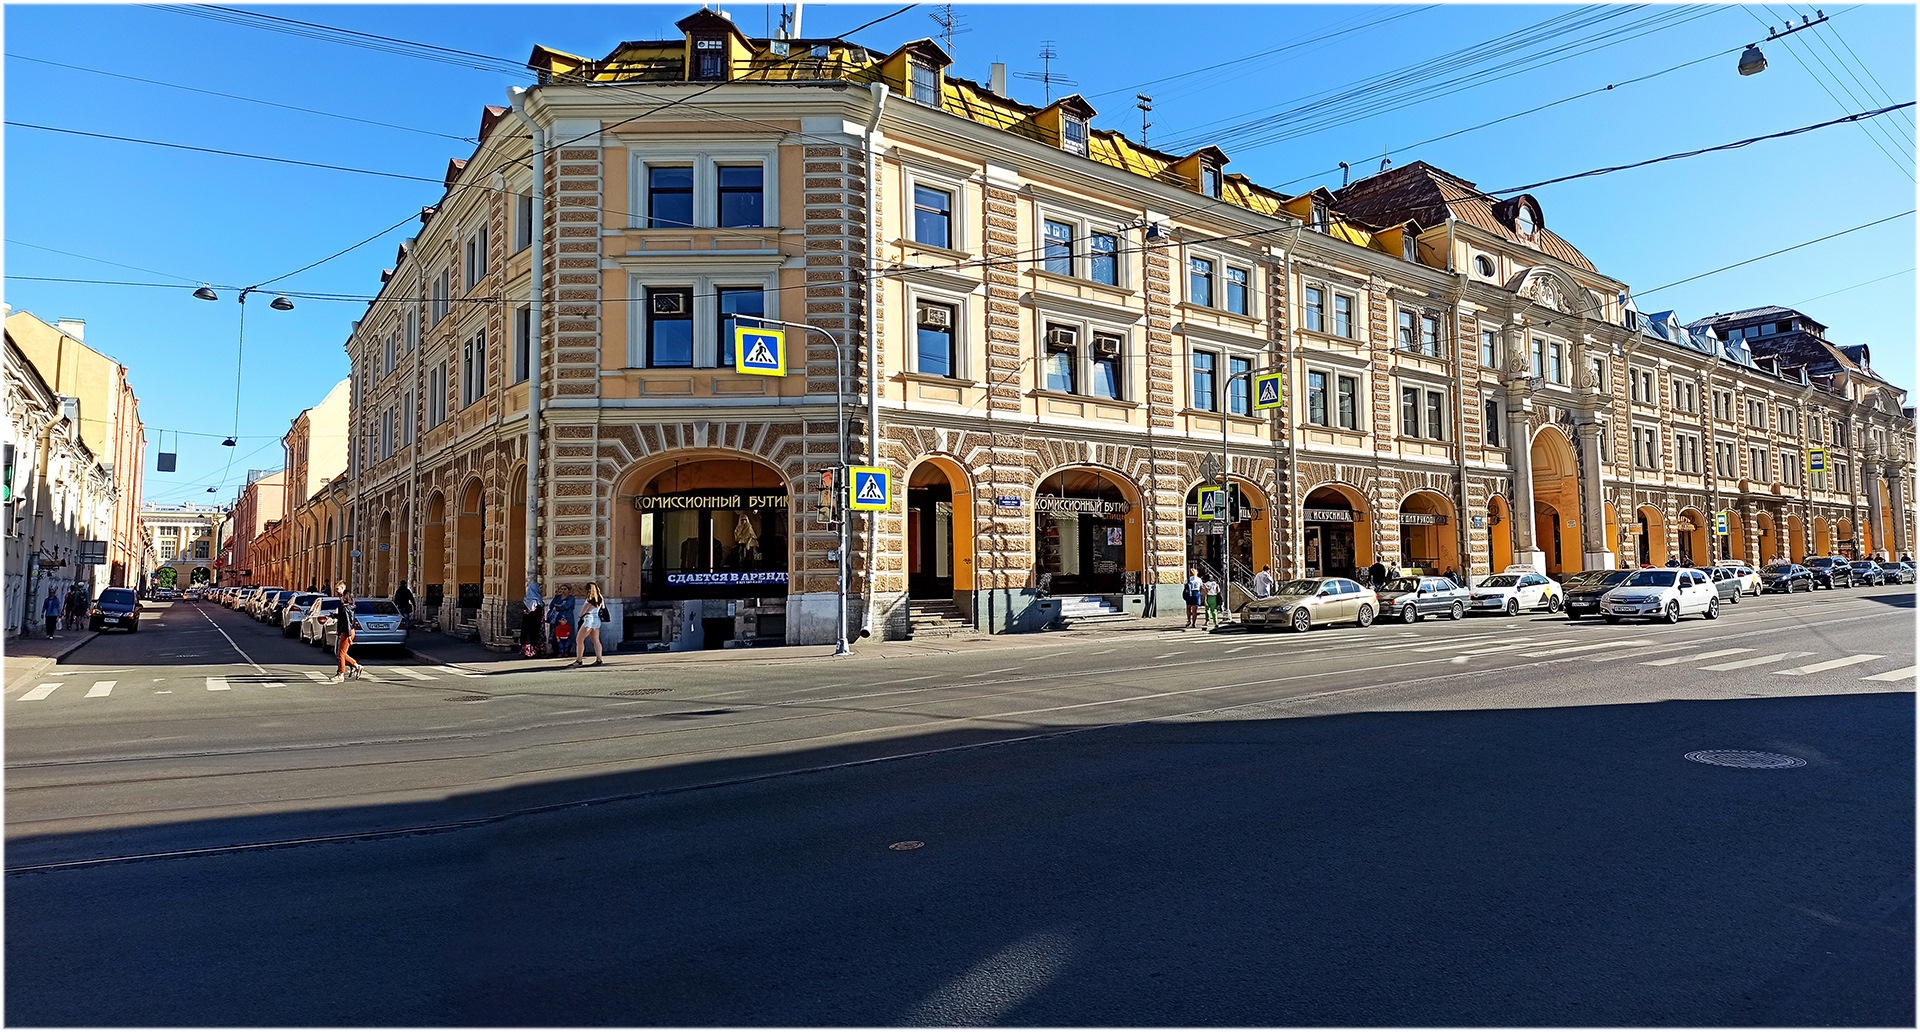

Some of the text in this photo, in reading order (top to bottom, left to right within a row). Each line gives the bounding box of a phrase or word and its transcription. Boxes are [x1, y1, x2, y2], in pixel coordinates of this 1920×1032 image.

[635, 494, 789, 509] КОМИССИОННЫЙ БУТИК
[1035, 498, 1103, 513] КОМИССИОННЫЙ
[667, 573, 728, 584] СДАЕТСЯ
[730, 573, 739, 581] В
